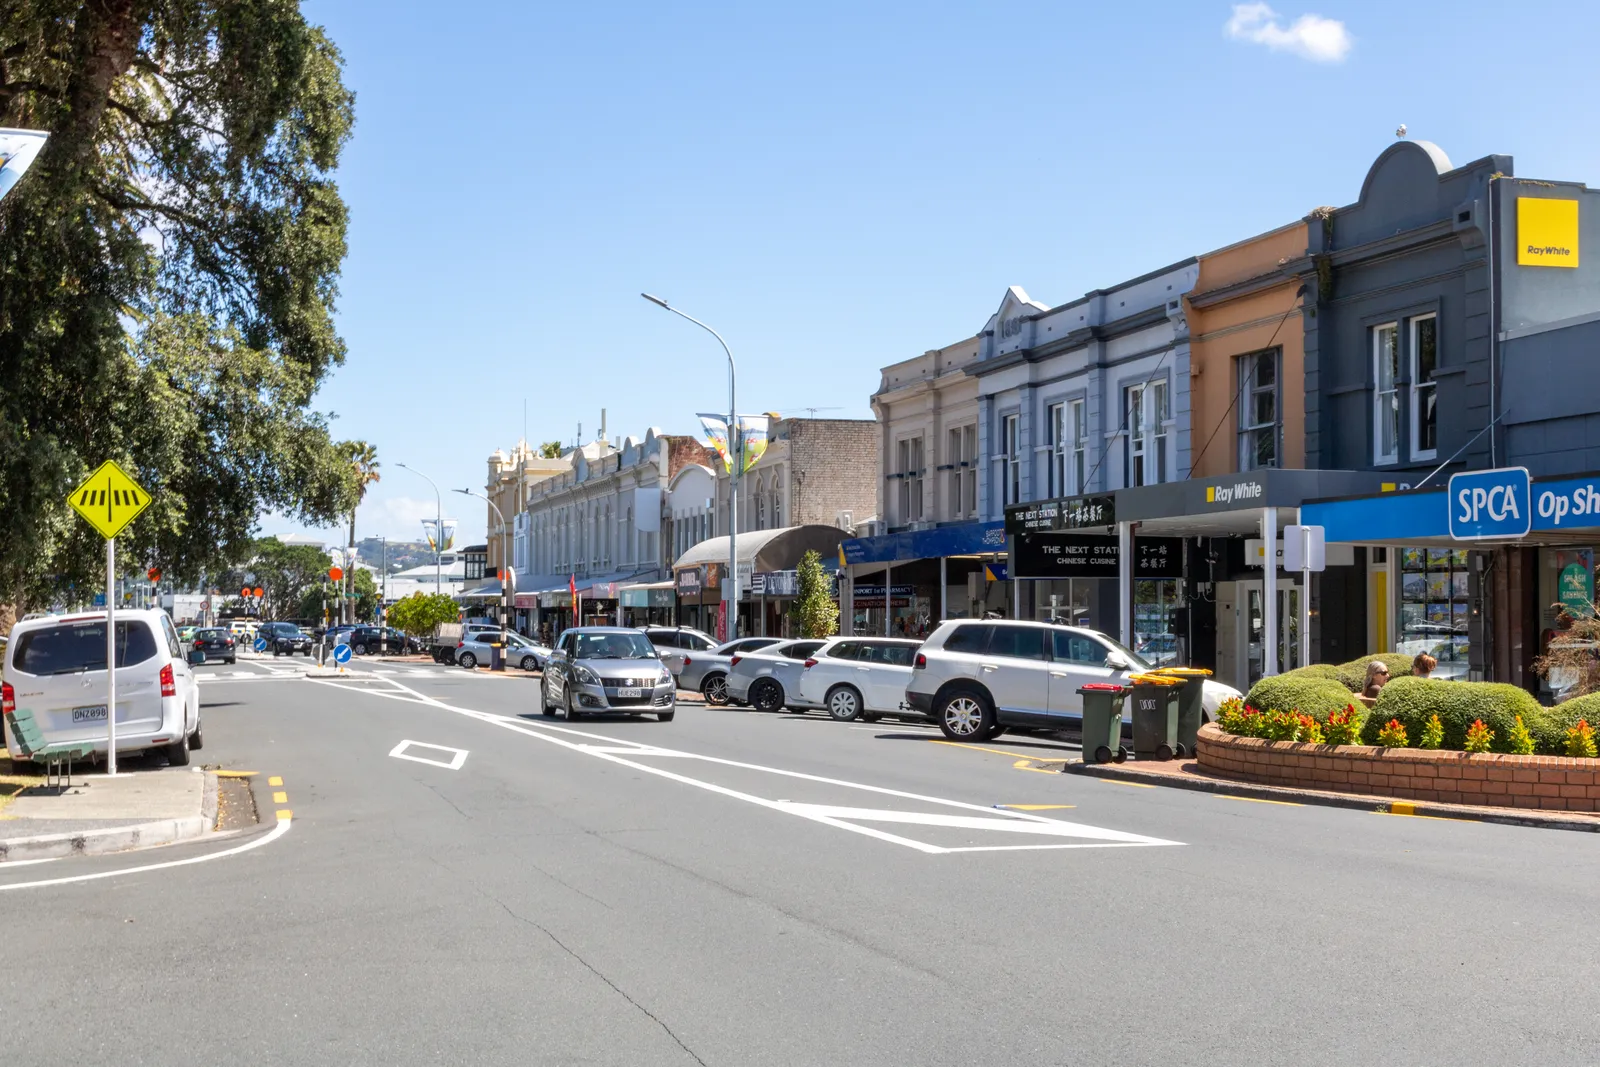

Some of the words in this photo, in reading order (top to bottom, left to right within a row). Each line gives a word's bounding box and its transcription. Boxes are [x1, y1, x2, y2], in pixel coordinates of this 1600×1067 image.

[1215, 486, 1233, 503] Ray
[1234, 482, 1262, 499] White
[1458, 485, 1520, 523] SPCA
[1538, 491, 1569, 525] Op
[1015, 512, 1024, 520] THE
[1025, 510, 1037, 520] NEXT
[1038, 508, 1058, 518] STATION
[1042, 546, 1061, 554] THE
[1065, 546, 1090, 554] NEXT
[1094, 546, 1120, 554] STATI
[1057, 557, 1087, 565] CHINESE
